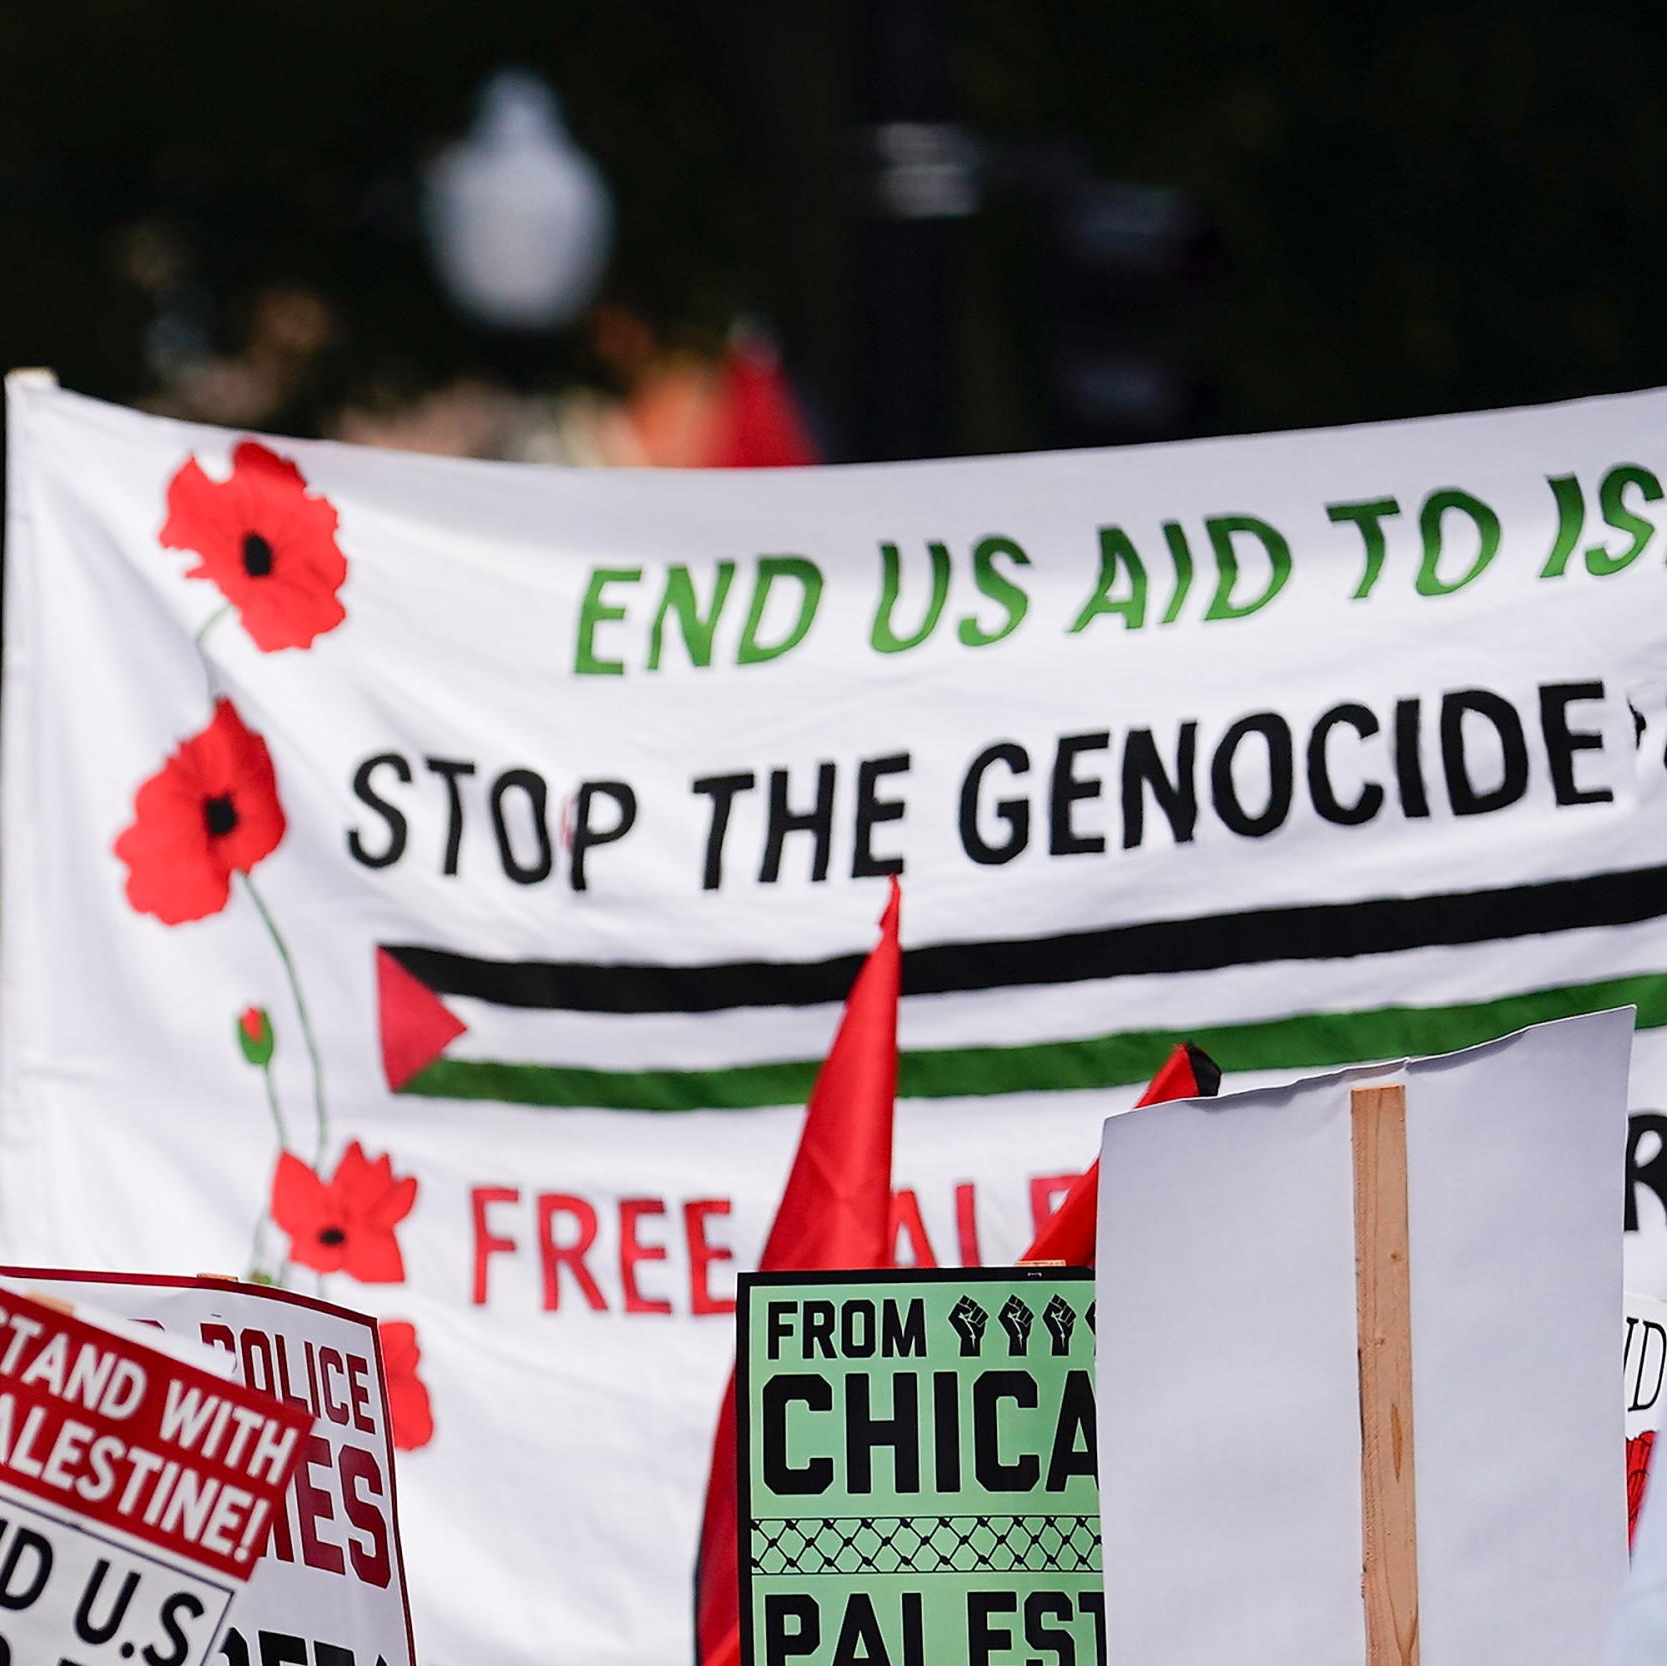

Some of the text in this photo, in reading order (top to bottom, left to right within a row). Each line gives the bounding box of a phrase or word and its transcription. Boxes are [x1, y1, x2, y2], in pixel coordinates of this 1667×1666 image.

[573, 554, 825, 676] END
[870, 536, 1032, 654] US
[1068, 513, 1294, 635] AID
[1323, 488, 1503, 600] TO
[347, 752, 637, 892] STOP
[692, 751, 911, 890] THE
[958, 679, 1614, 865] GENOCIDE
[470, 1187, 735, 1315] FREE
[767, 1298, 927, 1360] FROM
[159, 1377, 298, 1488] WITH
[763, 1370, 1098, 1495] CHICA
[264, 1436, 392, 1589] ES
